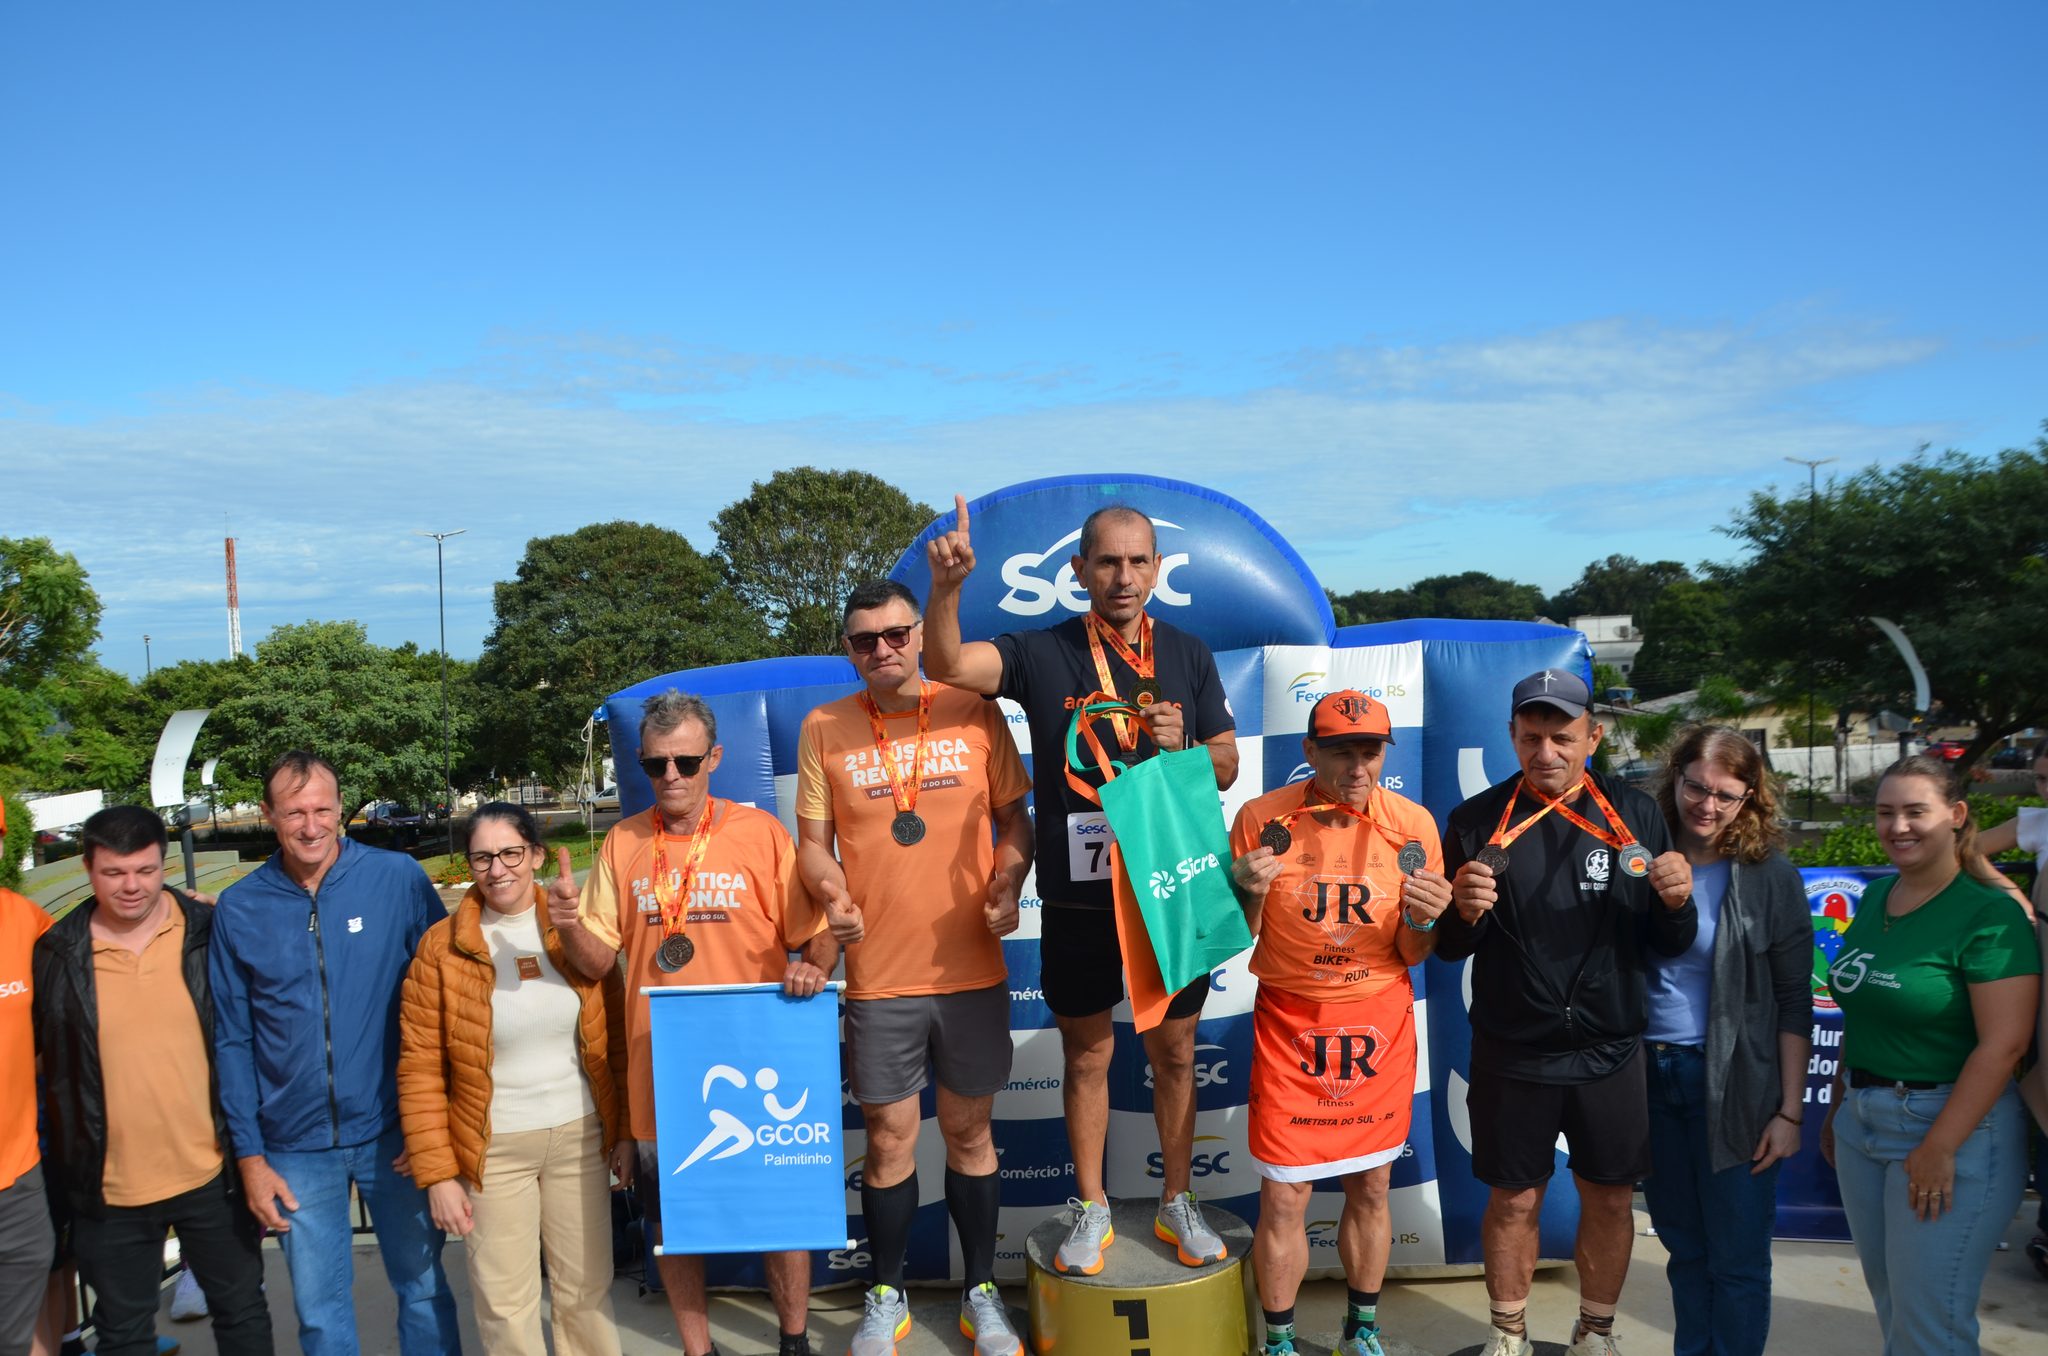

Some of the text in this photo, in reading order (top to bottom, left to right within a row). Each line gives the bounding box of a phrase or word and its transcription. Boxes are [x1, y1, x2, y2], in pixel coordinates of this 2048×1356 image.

[998, 551, 1192, 616] Sec
[1386, 685, 1406, 697] RS
[844, 752, 867, 771] 2ª
[942, 778, 956, 786] SUL
[1385, 775, 1404, 790] RS
[871, 788, 881, 796] DE
[1076, 824, 1108, 835] Sesc
[1084, 841, 1112, 873] 7
[1176, 852, 1220, 885] Sicre
[1804, 881, 1860, 895] EGISLATIVO
[1303, 881, 1375, 925] JR
[1324, 943, 1356, 954] Fitness
[1344, 968, 1370, 983] RUN
[0, 979, 29, 999] SOL
[1300, 1034, 1378, 1081] JR
[1002, 1077, 1060, 1091] omércio
[1317, 1098, 1355, 1107] Fitness
[1290, 1115, 1338, 1126] AMETISTA
[1340, 1117, 1354, 1126] DO
[1356, 1114, 1375, 1124] SUL
[756, 1122, 831, 1147] GCOR
[764, 1153, 832, 1166] Palmitinho
[1000, 1162, 1075, 1179] omércio R
[1400, 1232, 1421, 1245] RS
